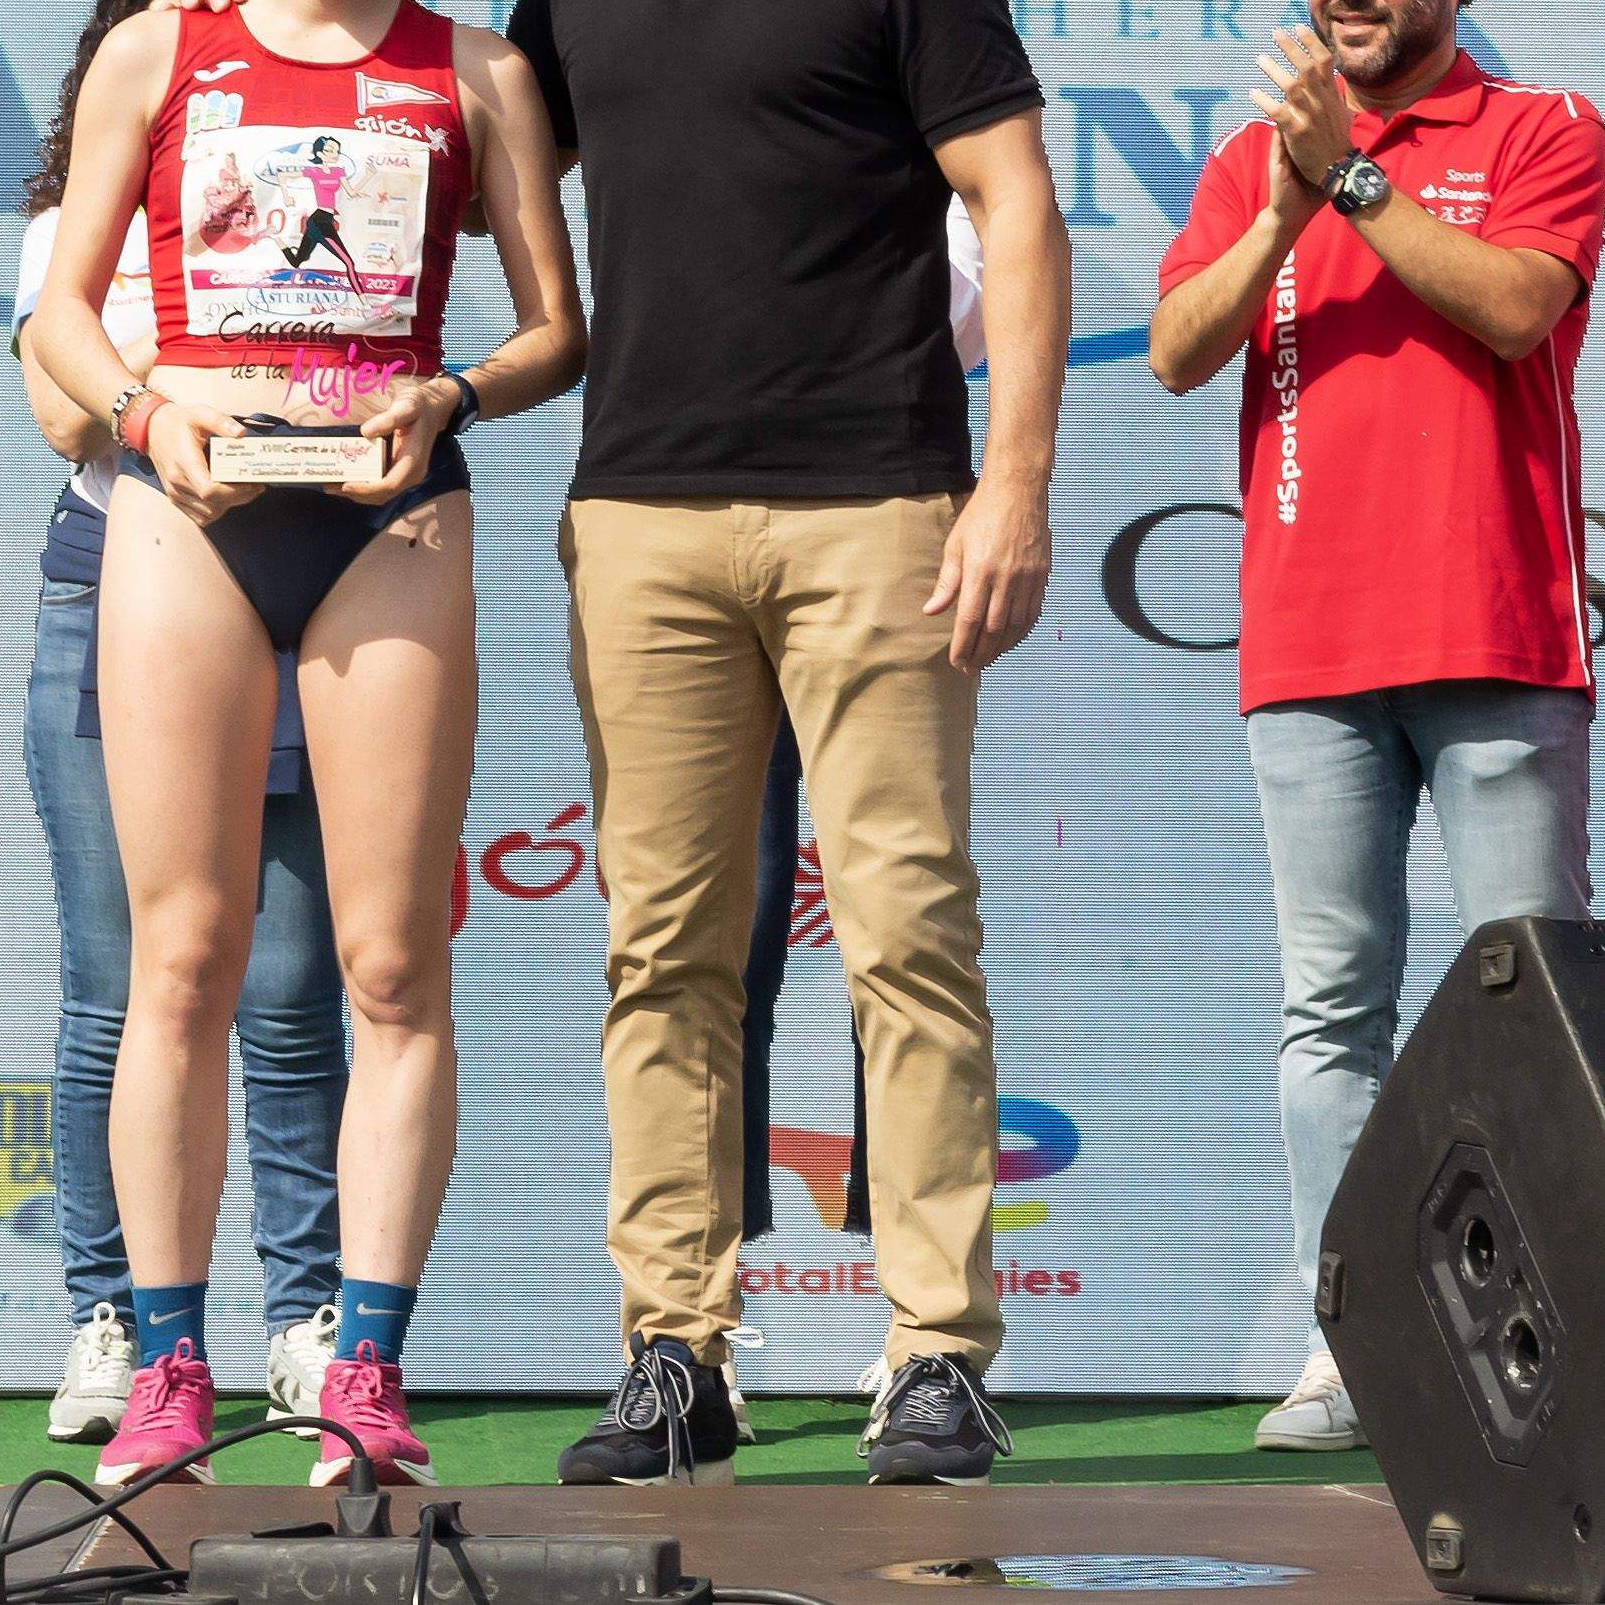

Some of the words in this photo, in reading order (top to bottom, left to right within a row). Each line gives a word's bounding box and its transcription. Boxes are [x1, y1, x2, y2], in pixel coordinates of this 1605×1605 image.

[218, 305, 339, 345] Carrera
[231, 352, 259, 379] de
[266, 350, 286, 380] la
[281, 342, 406, 418] Mujer
